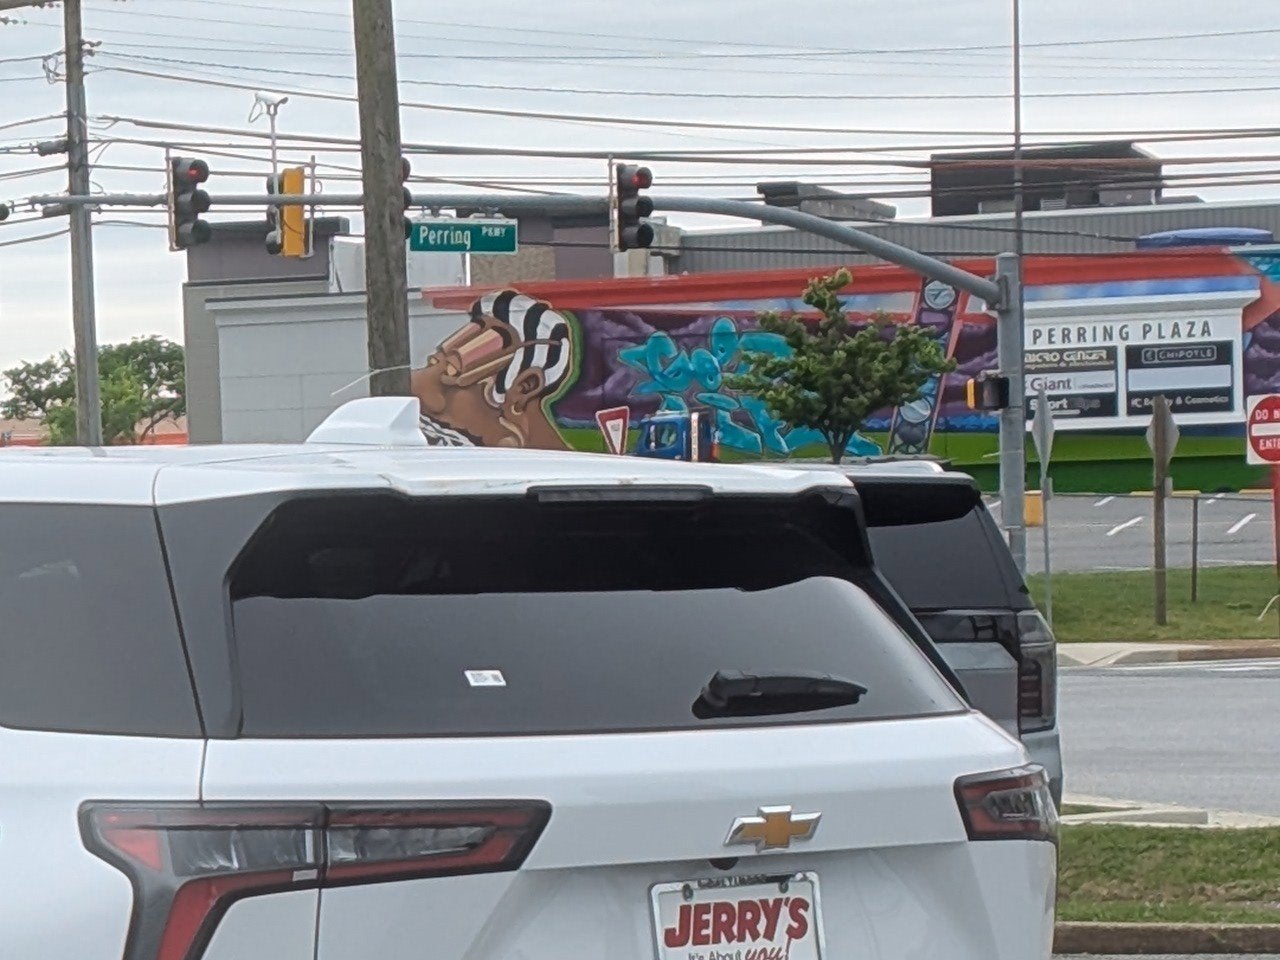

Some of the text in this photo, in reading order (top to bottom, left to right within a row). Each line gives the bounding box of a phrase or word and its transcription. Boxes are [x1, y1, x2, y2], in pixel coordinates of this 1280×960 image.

[420, 225, 470, 250] Perring
[1032, 320, 1212, 345] PERRING PLAZA
[1158, 348, 1213, 360] CHIPOTLE
[1030, 377, 1072, 392] Giant
[1029, 398, 1068, 410] Sort
[1255, 409, 1269, 420] DO
[664, 897, 810, 948] JERRY'S
